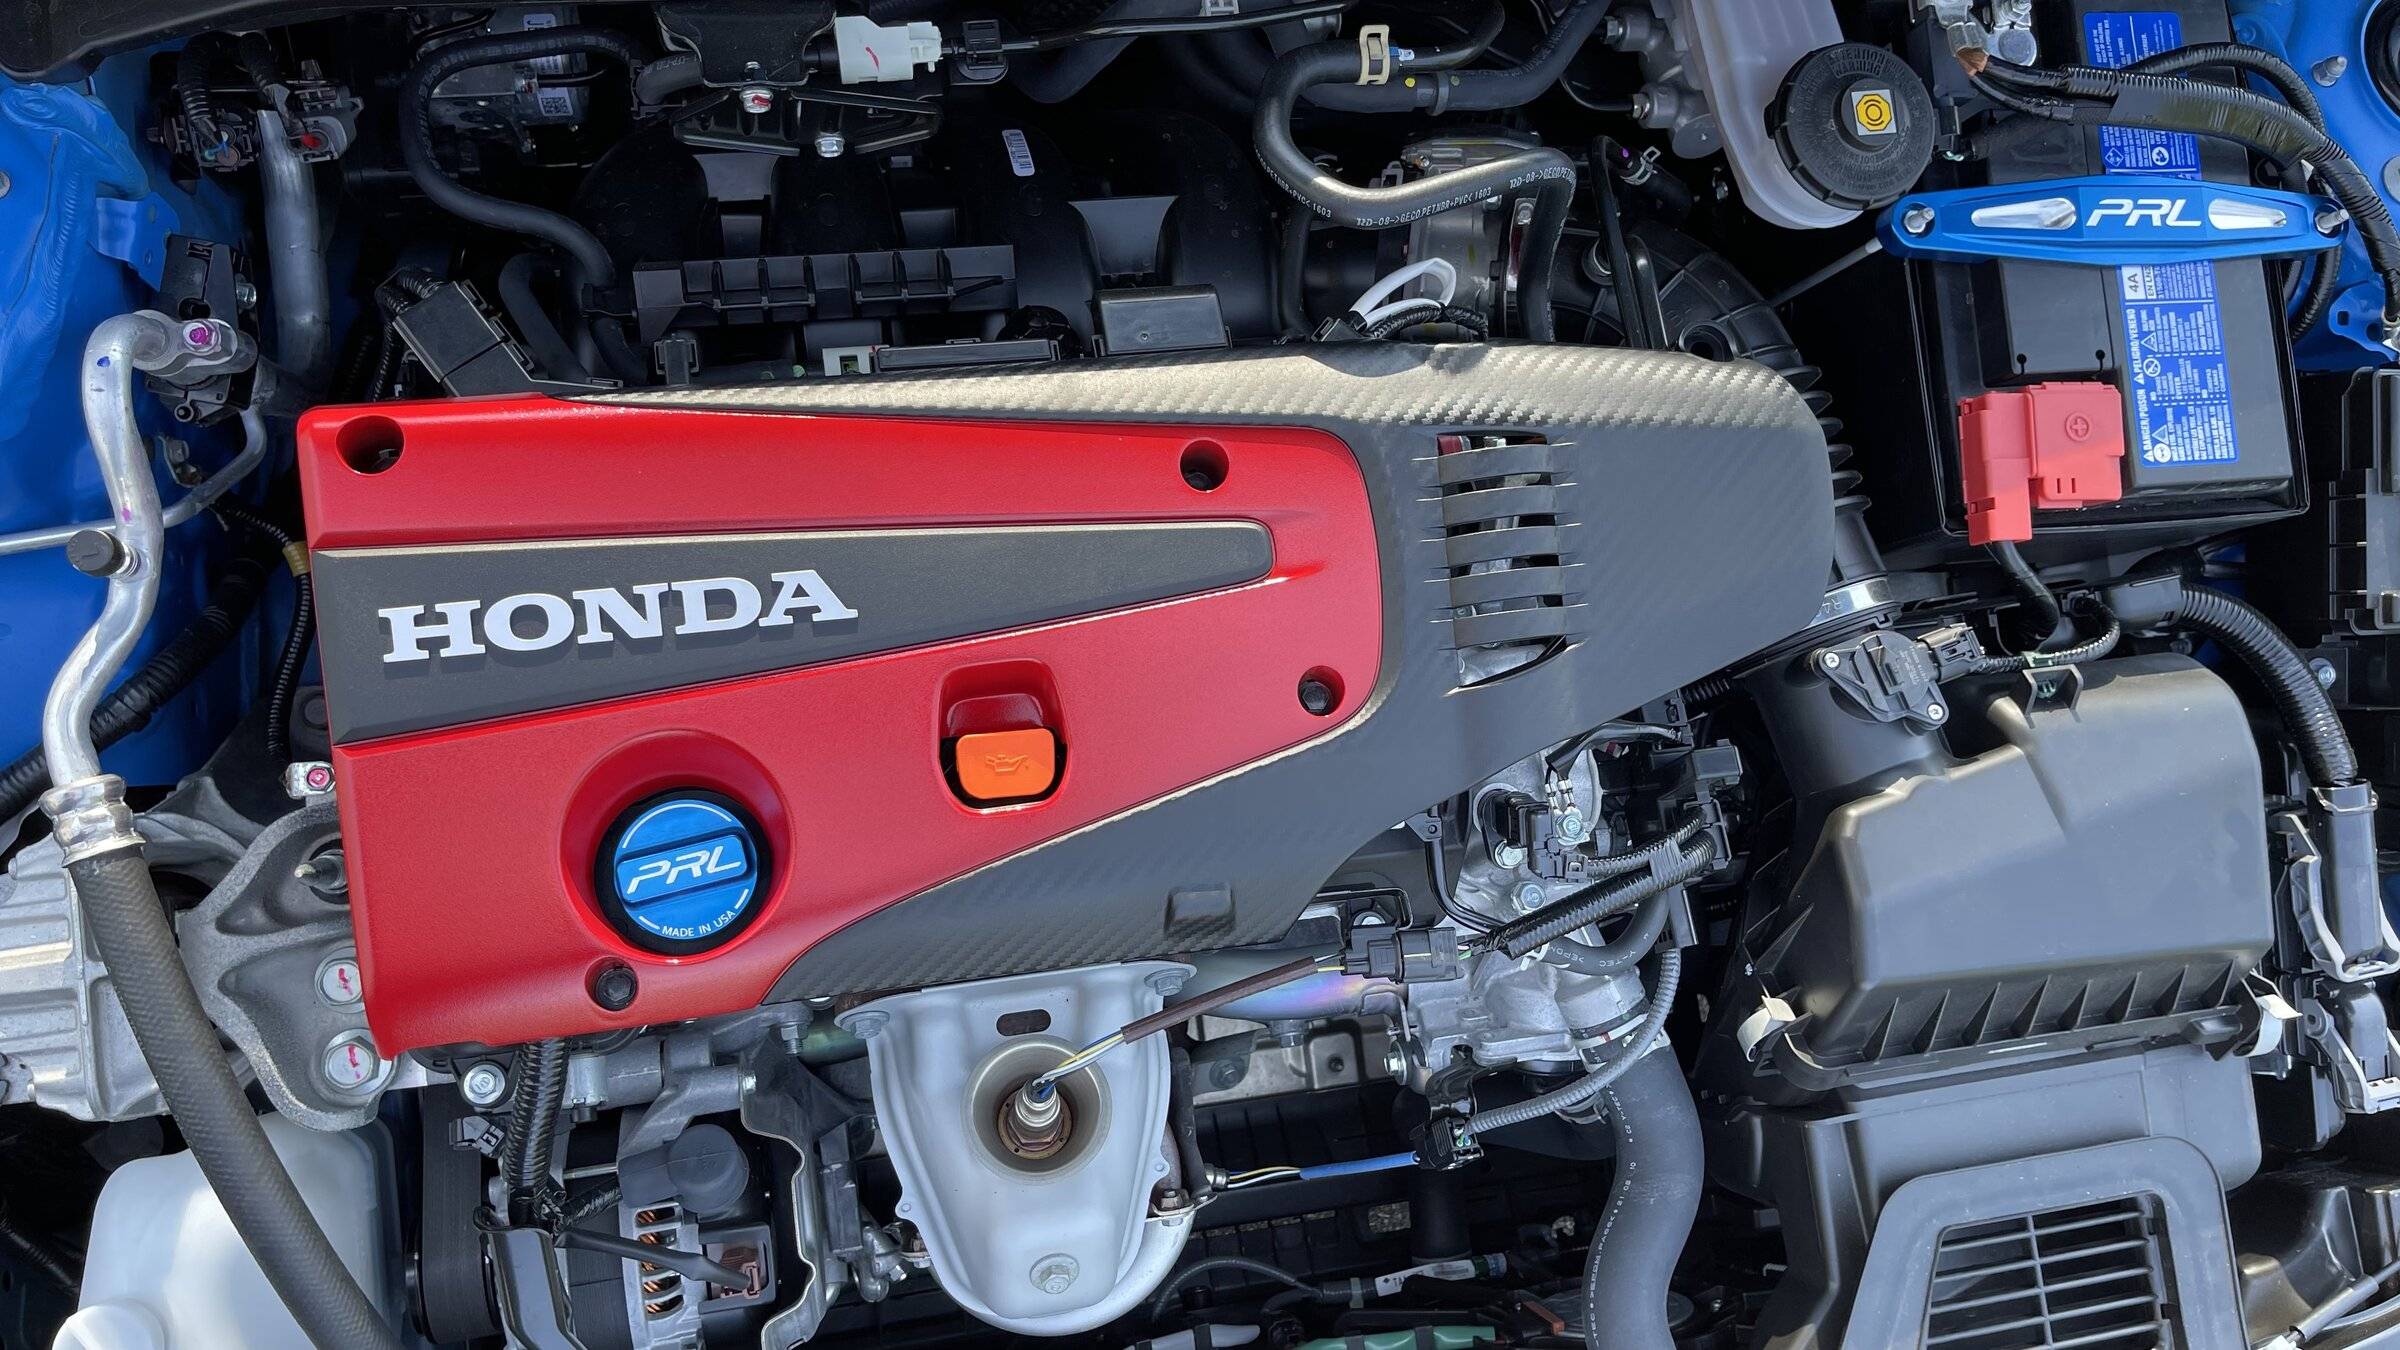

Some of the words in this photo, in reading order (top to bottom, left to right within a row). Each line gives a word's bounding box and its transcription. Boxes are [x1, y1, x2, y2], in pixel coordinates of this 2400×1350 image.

[2085, 199, 2201, 227] PRL
[2128, 273, 2139, 293] 4A
[378, 569, 858, 662] HONDA
[627, 846, 742, 894] PRL
[662, 925, 695, 937] MADE
[699, 923, 711, 934] IN
[713, 910, 736, 928] USA
